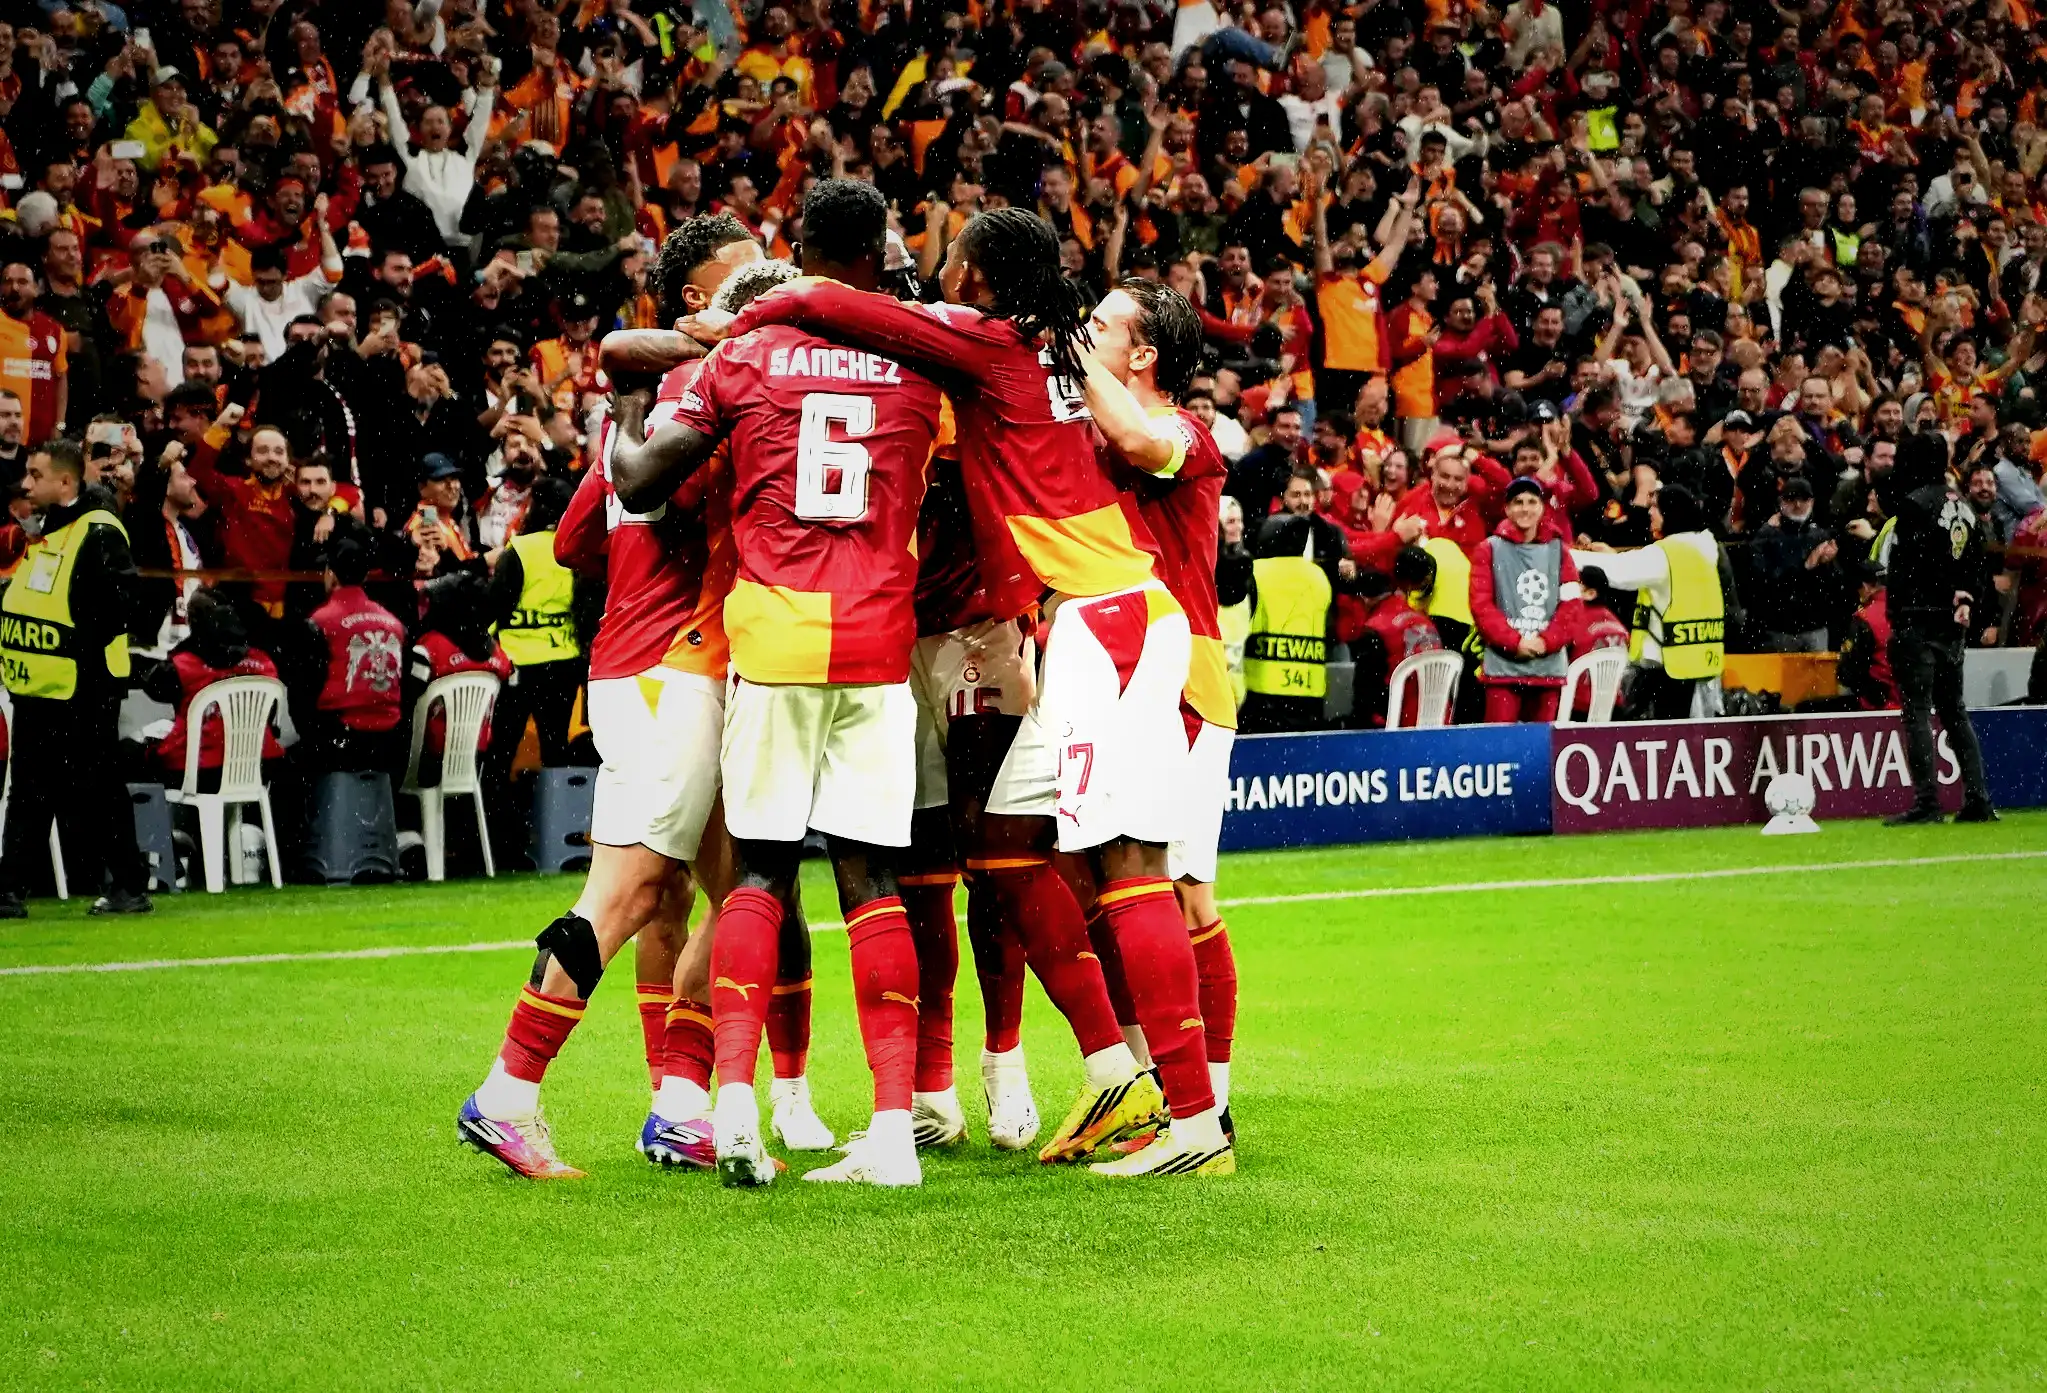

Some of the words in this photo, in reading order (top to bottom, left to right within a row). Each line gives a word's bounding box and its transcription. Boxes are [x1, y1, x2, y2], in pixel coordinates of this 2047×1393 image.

[769, 347, 902, 384] SANCHEZ
[795, 392, 876, 522] 6
[0, 616, 60, 650] WARD
[1255, 636, 1325, 661] STEWAR
[1673, 621, 1724, 644] STEWA
[0, 655, 30, 685] 34
[1224, 768, 1389, 811] HAMPIONS
[1554, 737, 1735, 816] QATAR
[1749, 729, 1961, 794] AIRWAS
